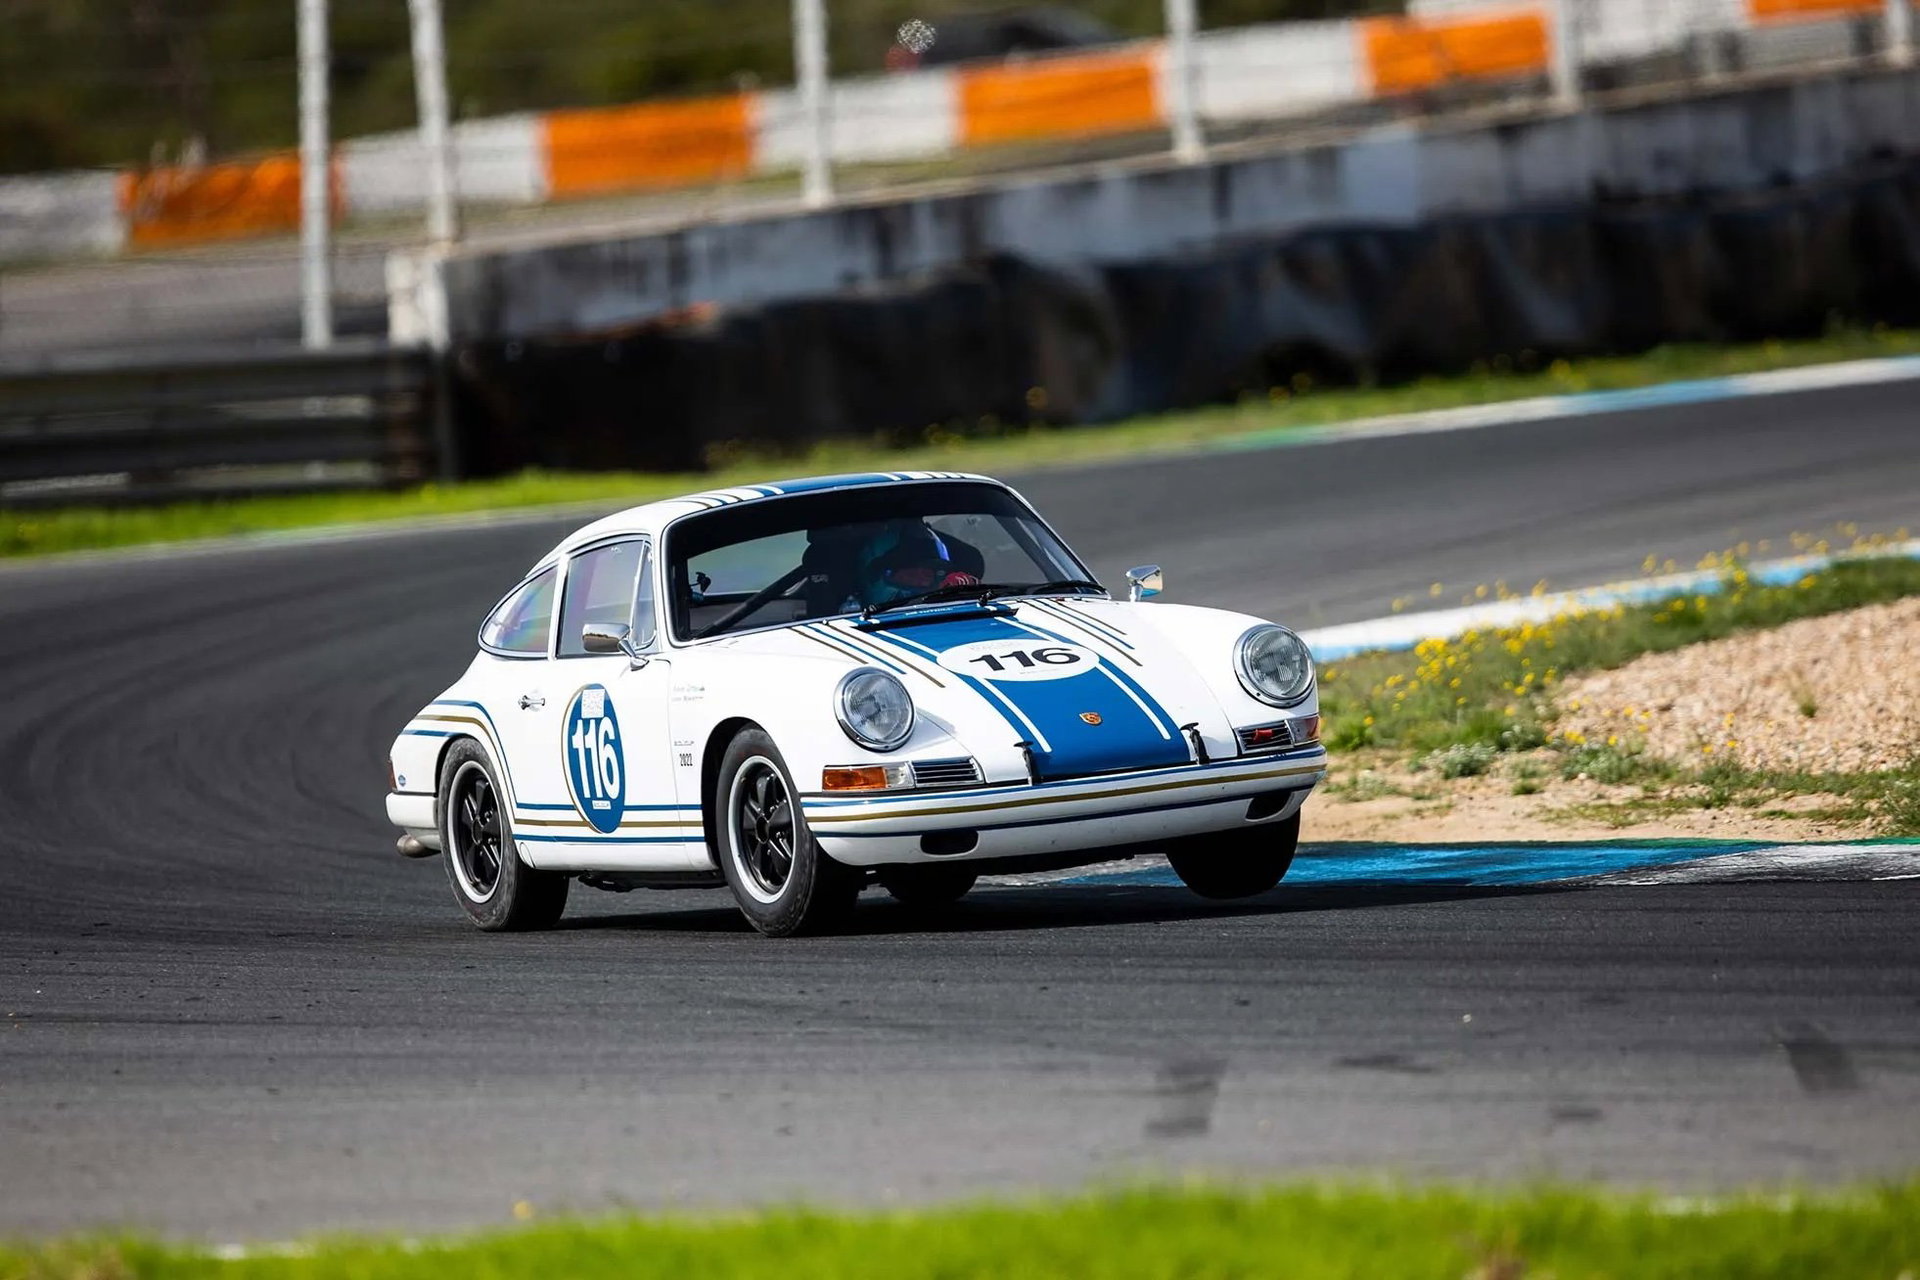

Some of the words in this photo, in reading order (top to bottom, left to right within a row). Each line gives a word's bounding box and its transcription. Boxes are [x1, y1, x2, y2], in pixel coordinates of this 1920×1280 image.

[969, 647, 1081, 671] 116
[572, 716, 620, 800] 116
[679, 752, 693, 767] 2022
